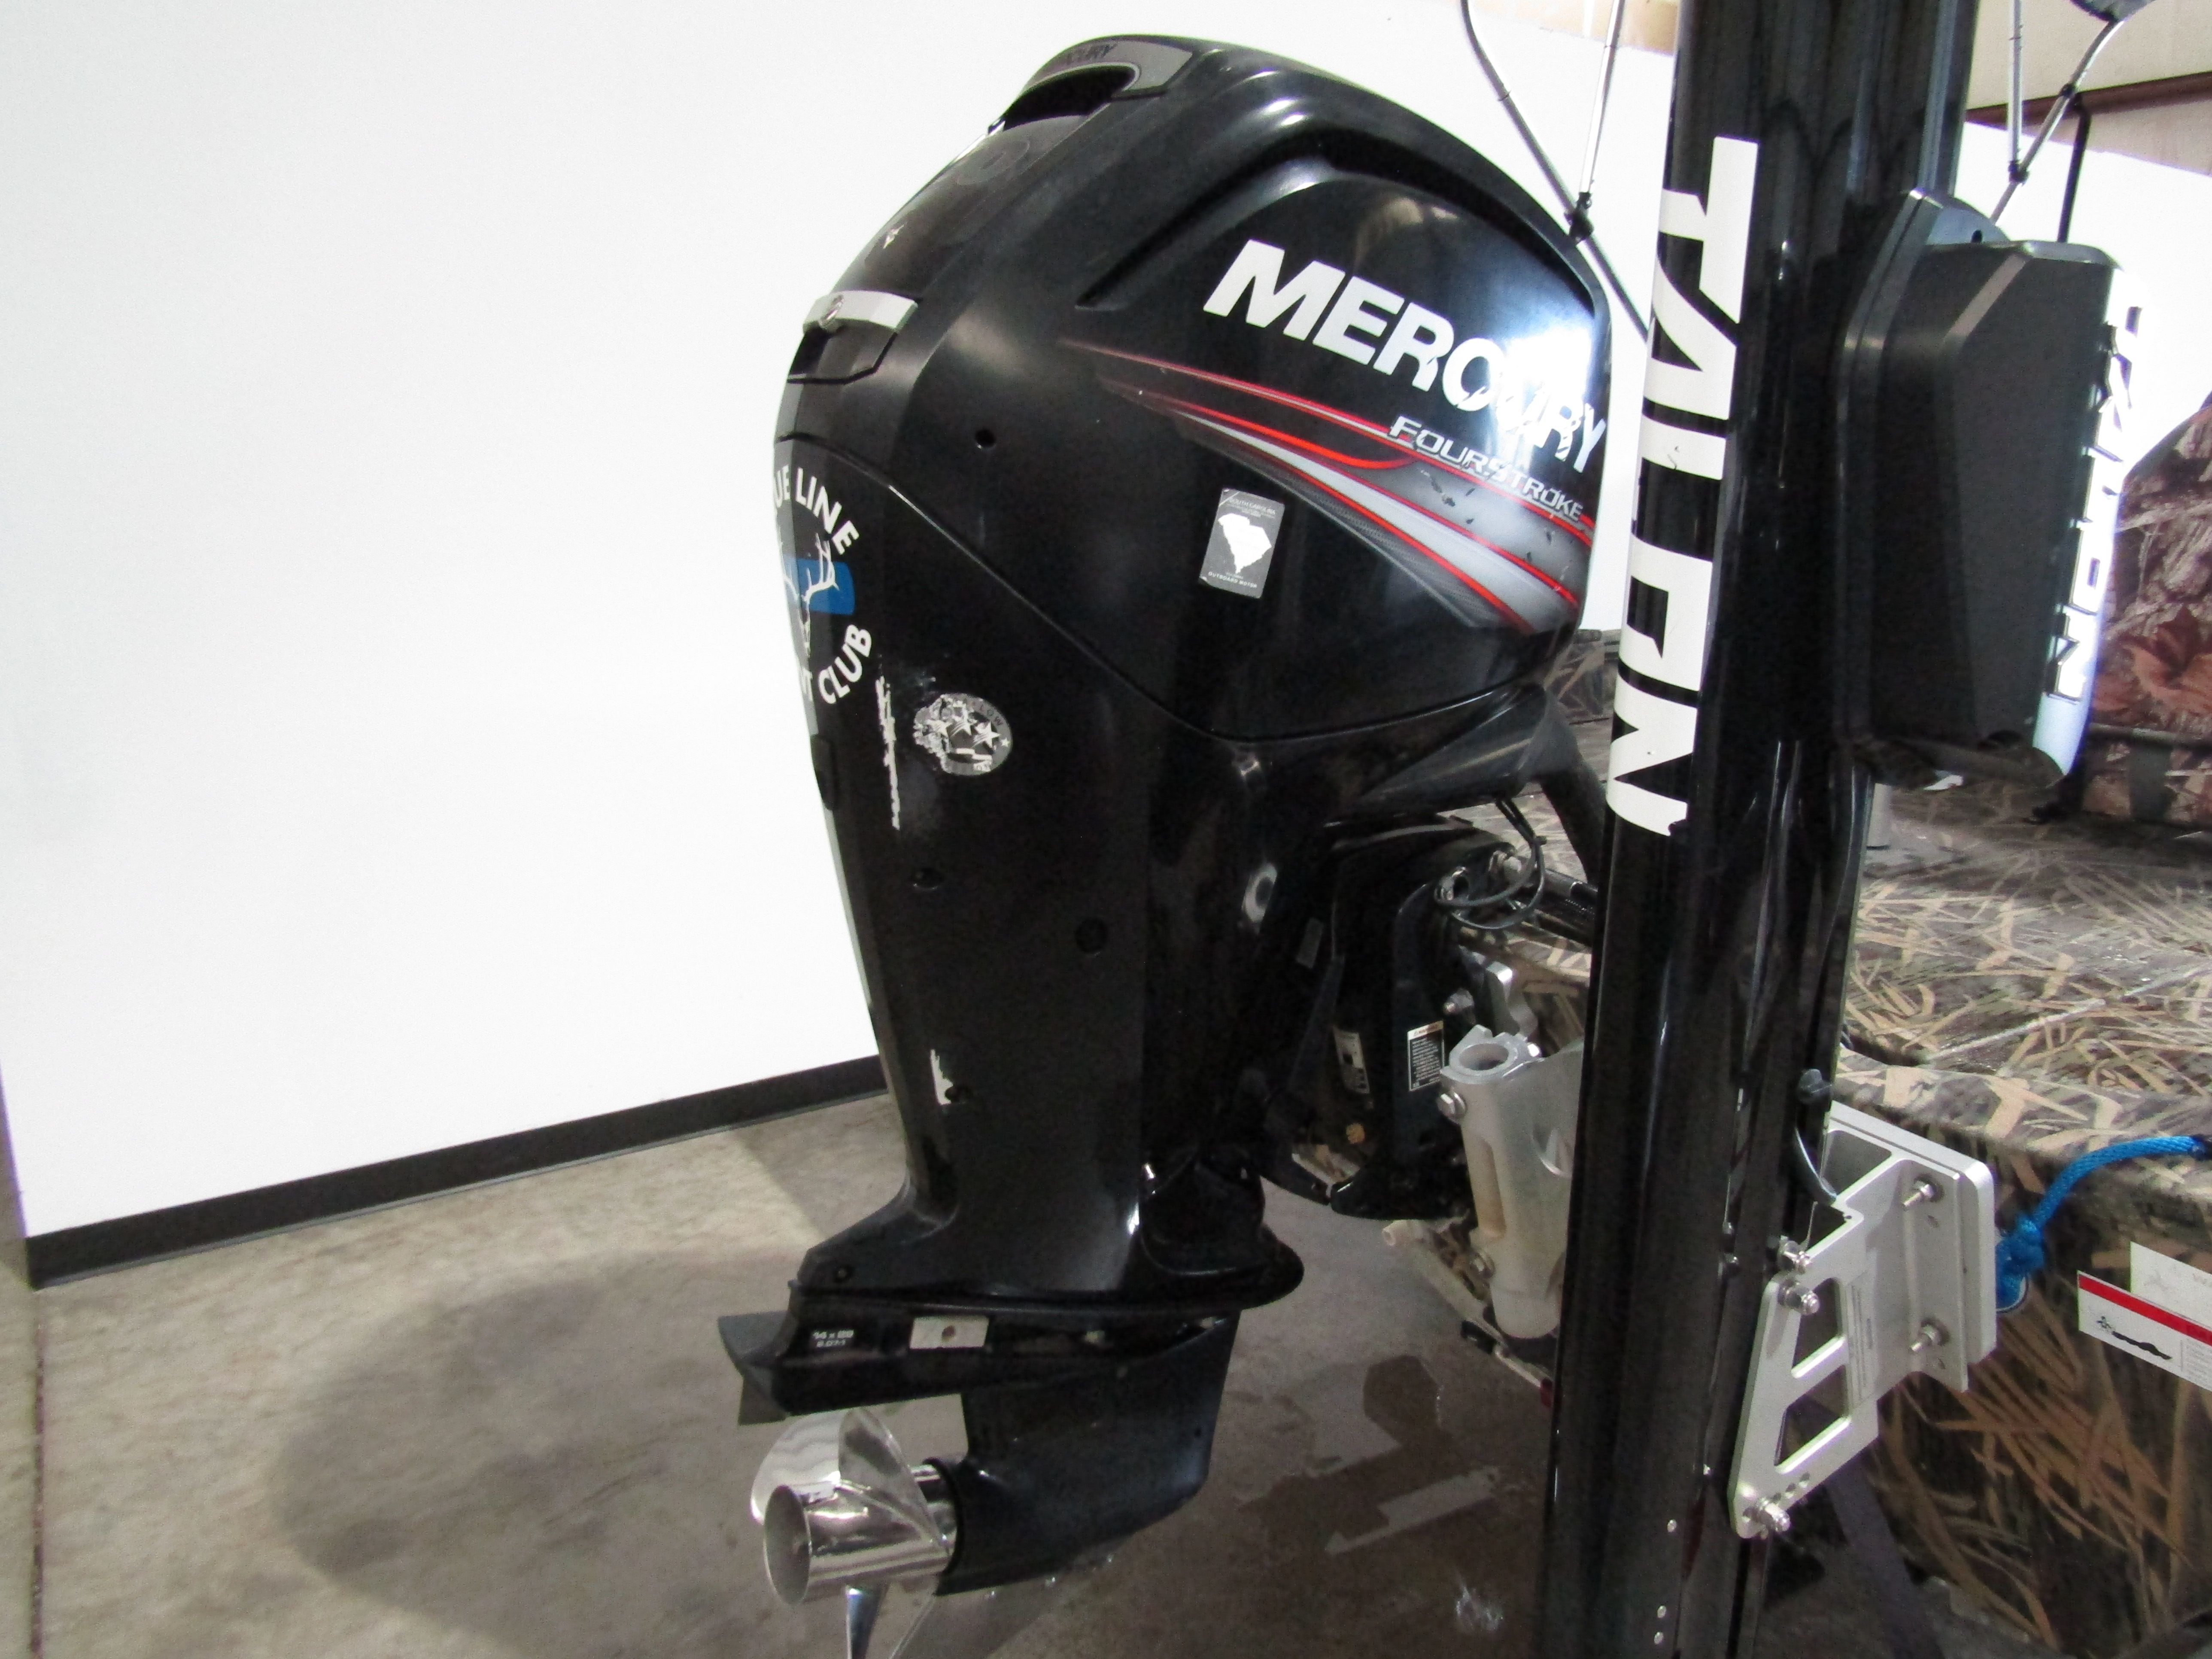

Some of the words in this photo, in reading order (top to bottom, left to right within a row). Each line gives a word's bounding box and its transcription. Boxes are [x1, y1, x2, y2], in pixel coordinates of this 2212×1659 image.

[1203, 239, 1606, 474] MERCURY
[796, 467, 859, 555] LINE
[1389, 416, 1583, 521] FOURSTROKE
[1605, 137, 1759, 836] TALON
[818, 624, 872, 704] CLUB
